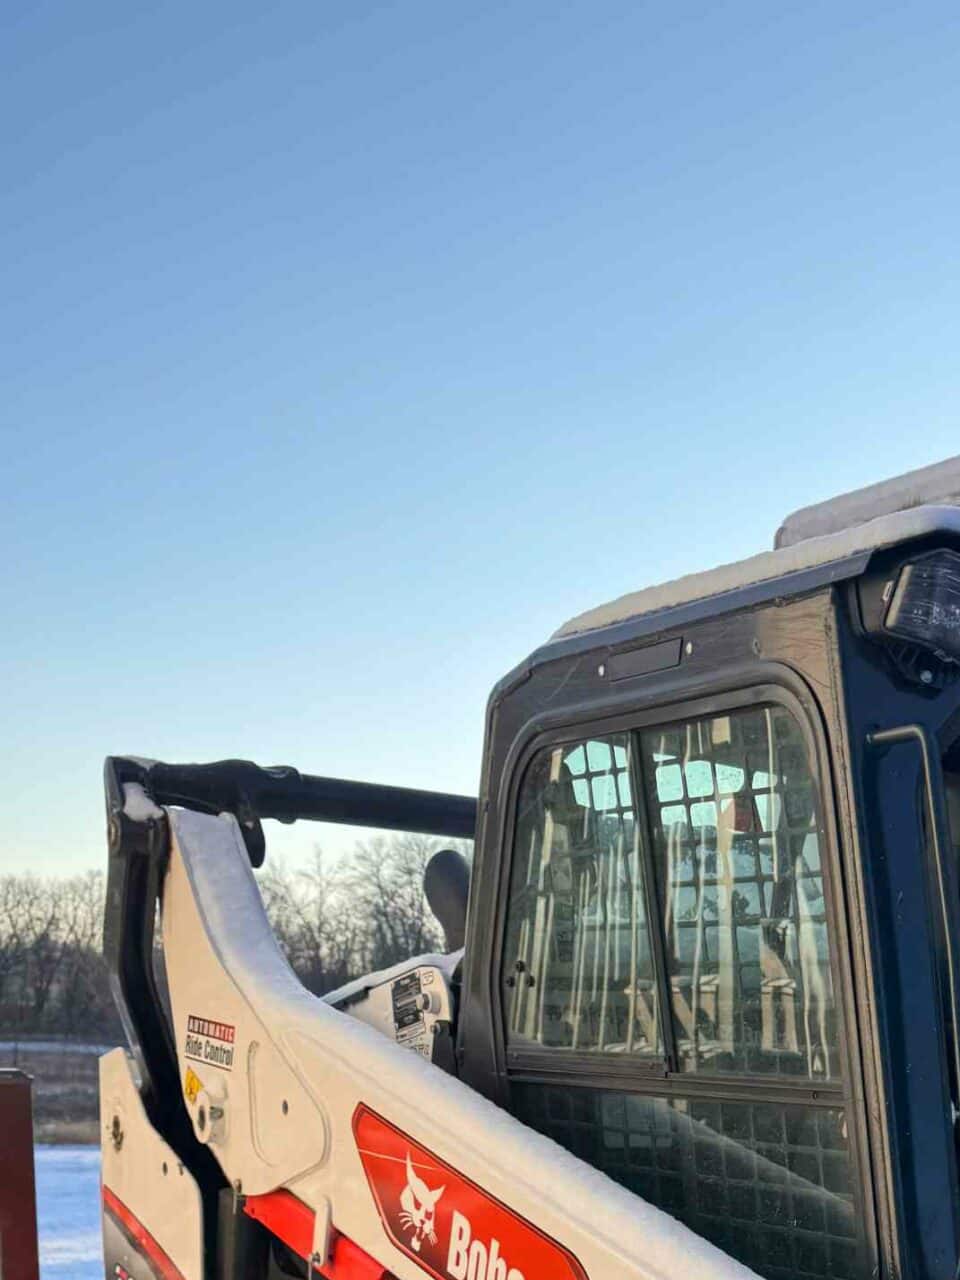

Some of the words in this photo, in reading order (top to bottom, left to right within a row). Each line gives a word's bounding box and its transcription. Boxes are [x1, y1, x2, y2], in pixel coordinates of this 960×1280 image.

[188, 1017, 234, 1042] AUTOMATIC
[186, 1035, 202, 1057] Ride
[204, 1040, 233, 1066] Control
